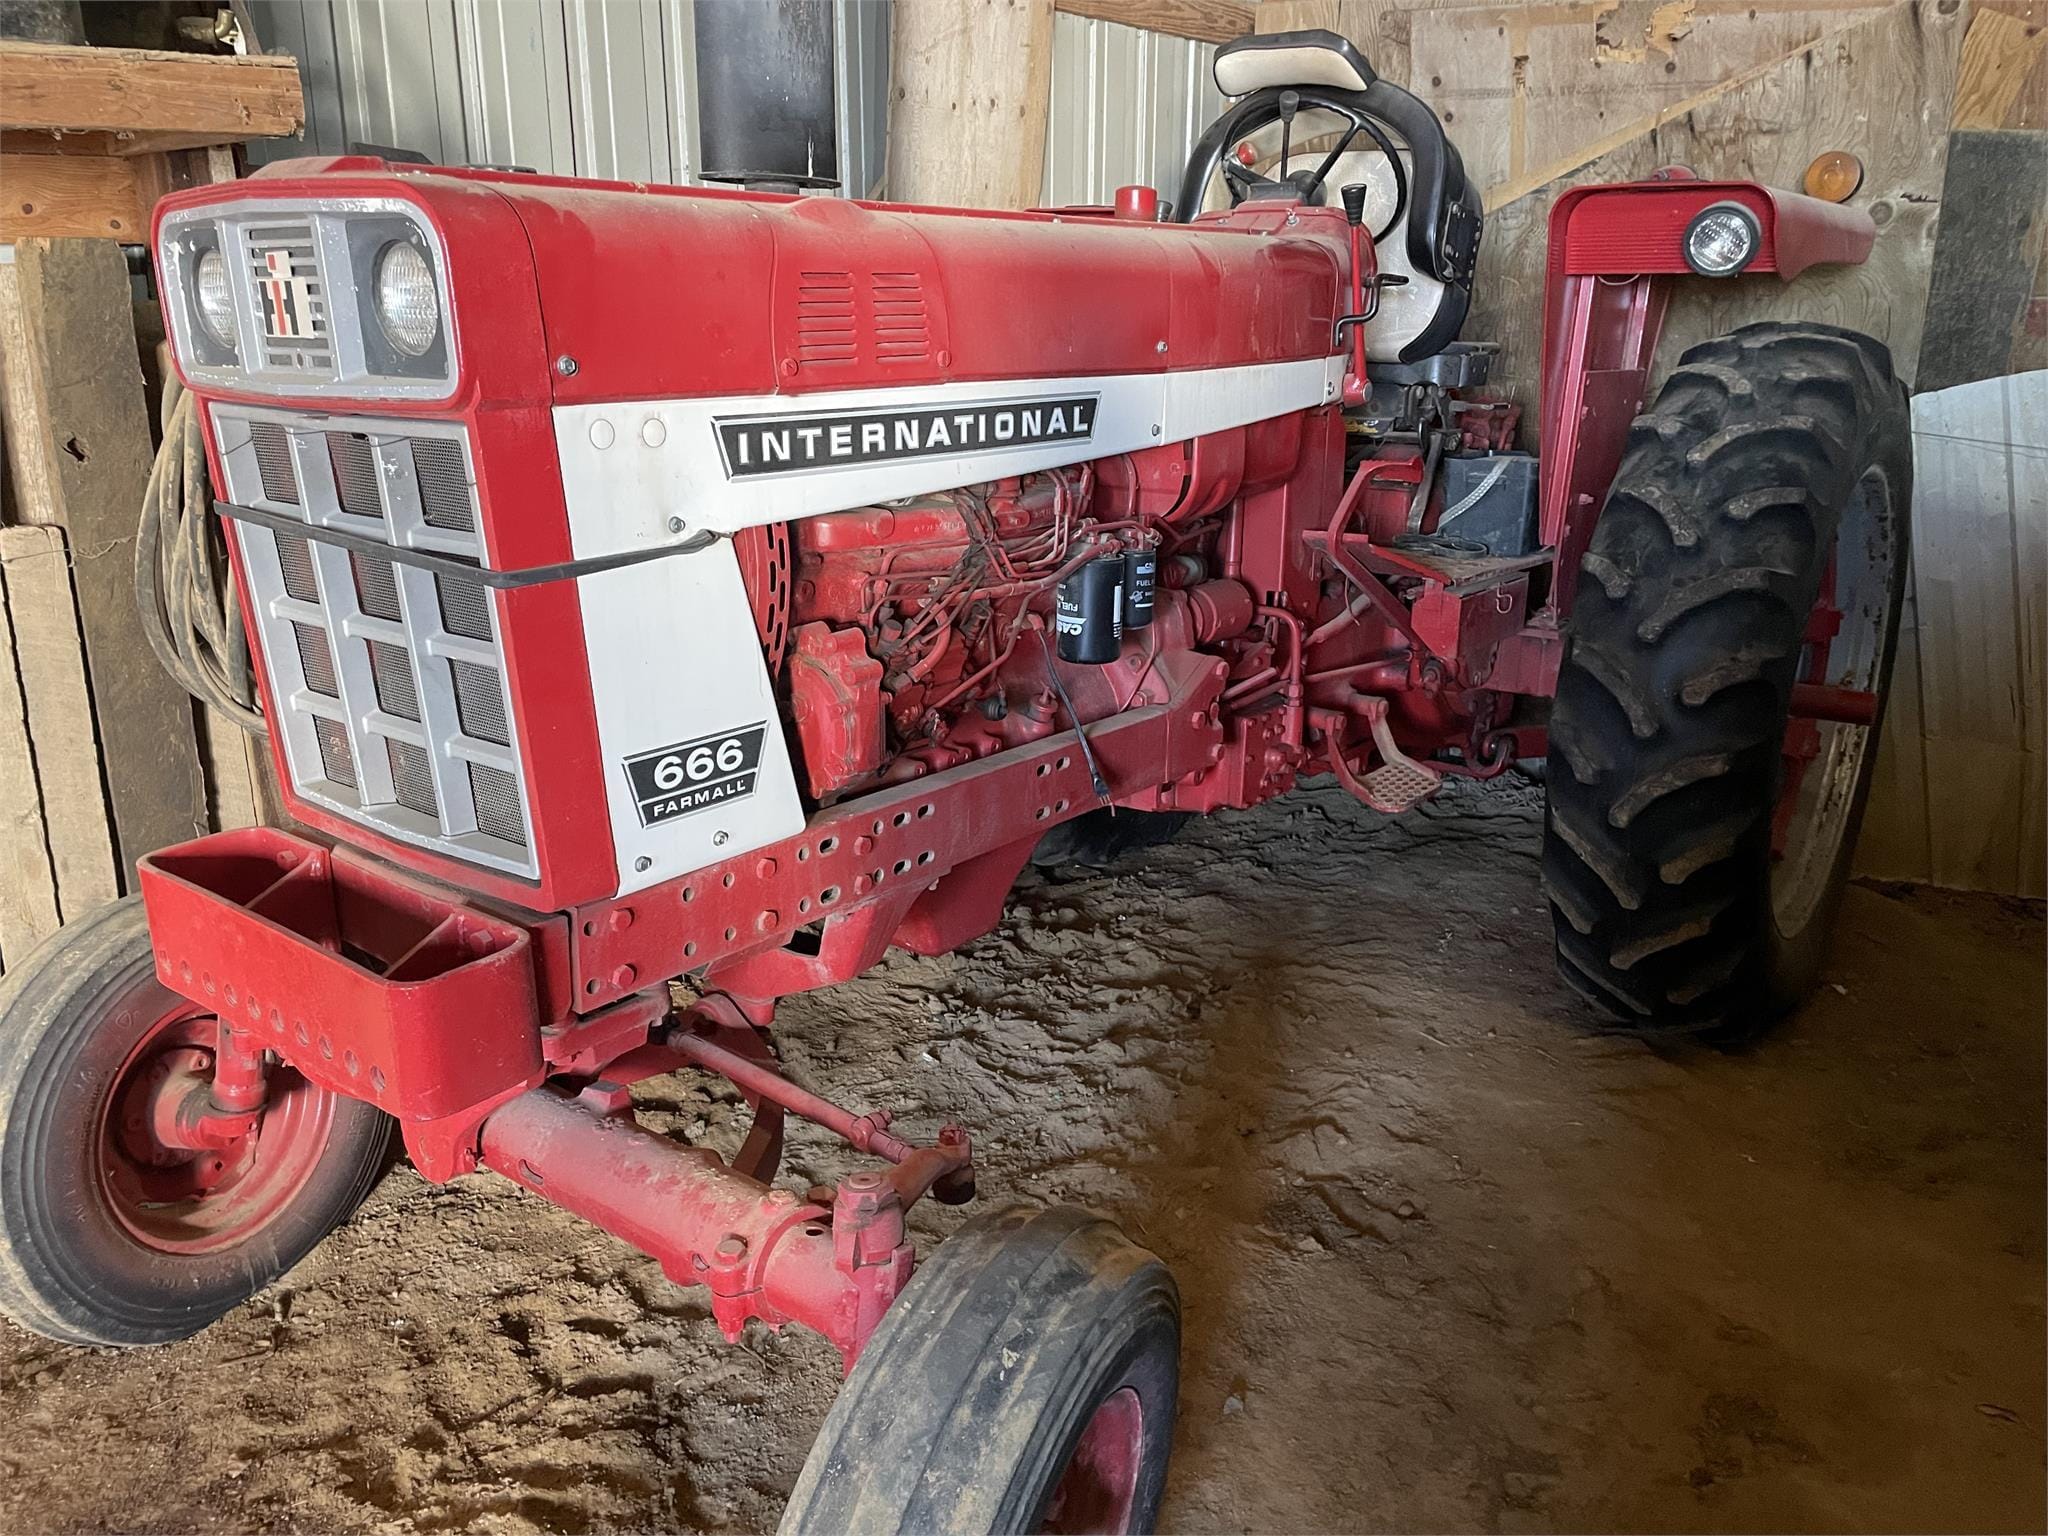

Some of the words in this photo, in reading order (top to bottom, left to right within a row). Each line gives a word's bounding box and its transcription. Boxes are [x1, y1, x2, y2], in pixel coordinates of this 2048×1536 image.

[737, 406, 1089, 465] INTERNATIONAL
[654, 739, 744, 790] 666
[653, 780, 746, 817] FARMALL
